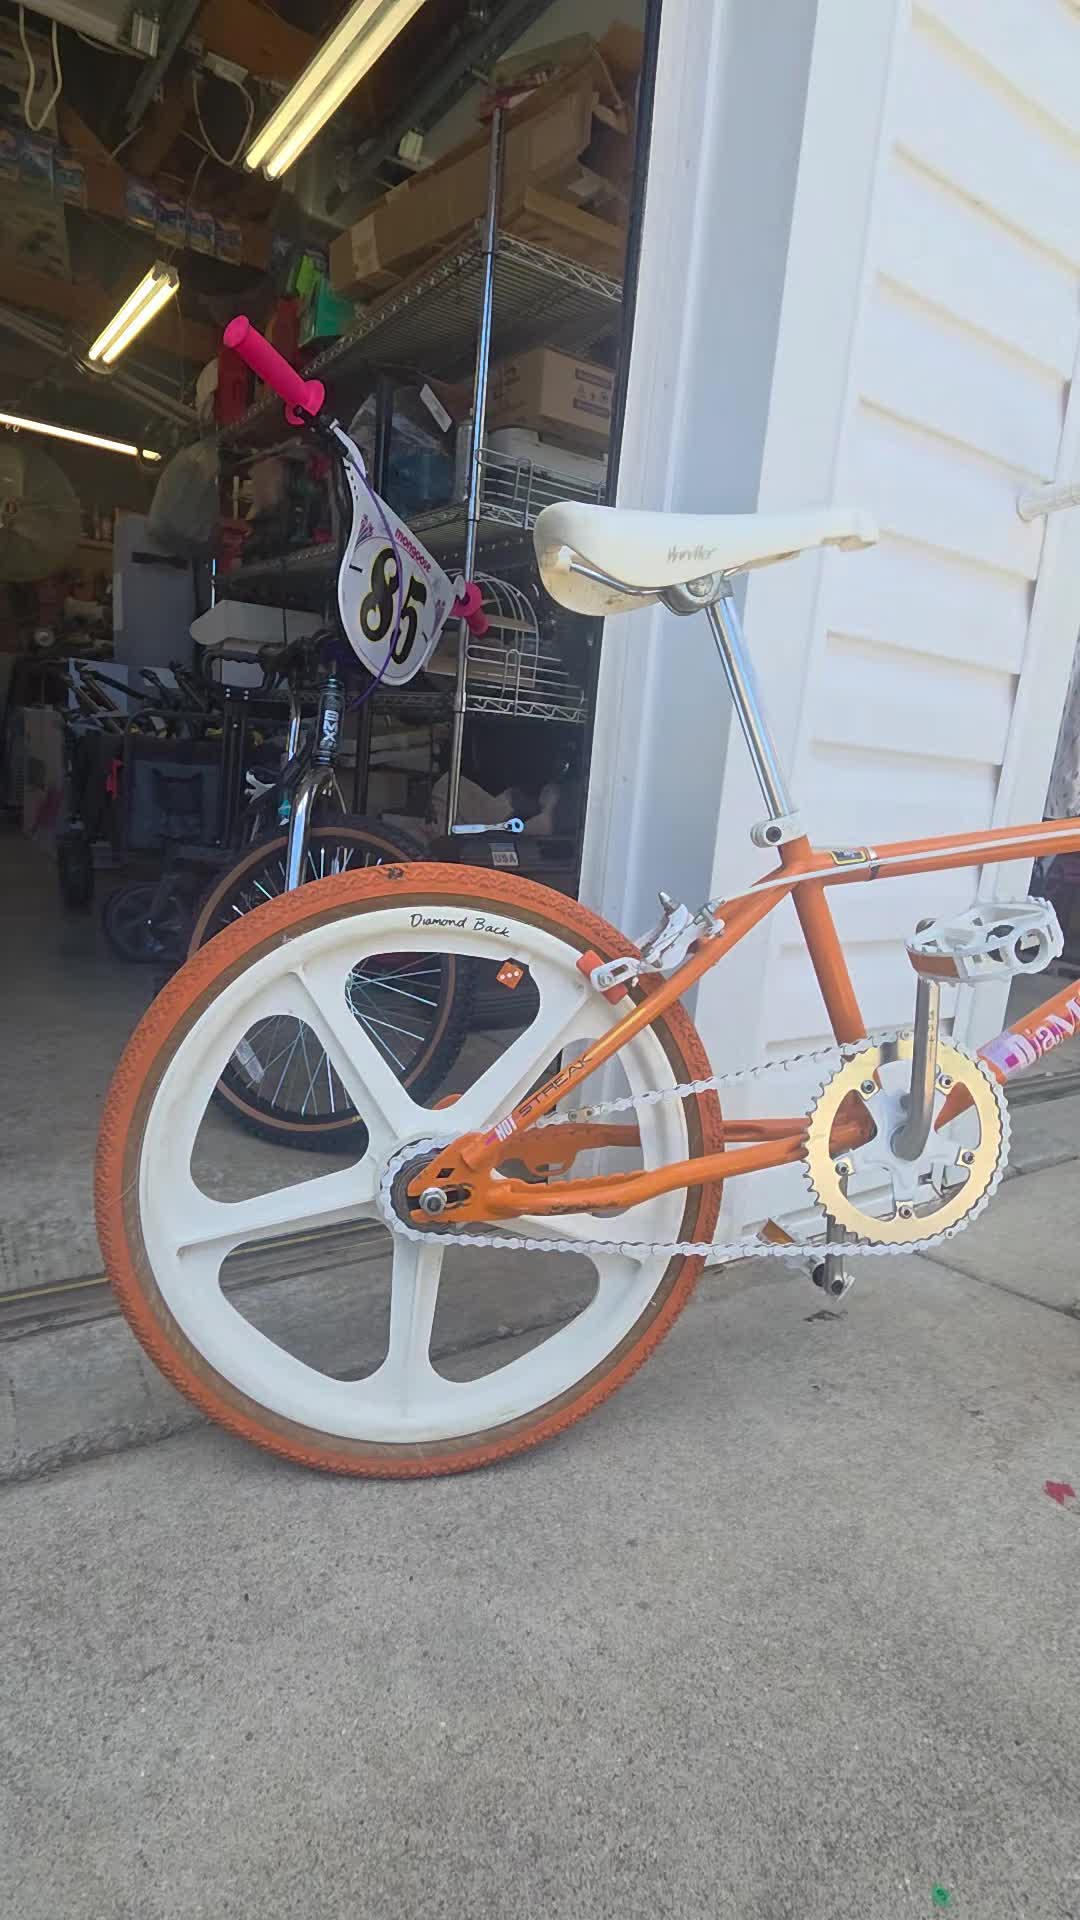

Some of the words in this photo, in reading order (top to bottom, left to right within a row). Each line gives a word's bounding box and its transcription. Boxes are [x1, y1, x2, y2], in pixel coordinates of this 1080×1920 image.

[394, 527, 432, 573] mongoose
[359, 546, 428, 666] 85
[322, 709, 339, 742] BMX
[493, 852, 518, 865] USA
[410, 913, 468, 928] Diamond
[473, 917, 511, 938] Back
[518, 1054, 593, 1118] STREAK
